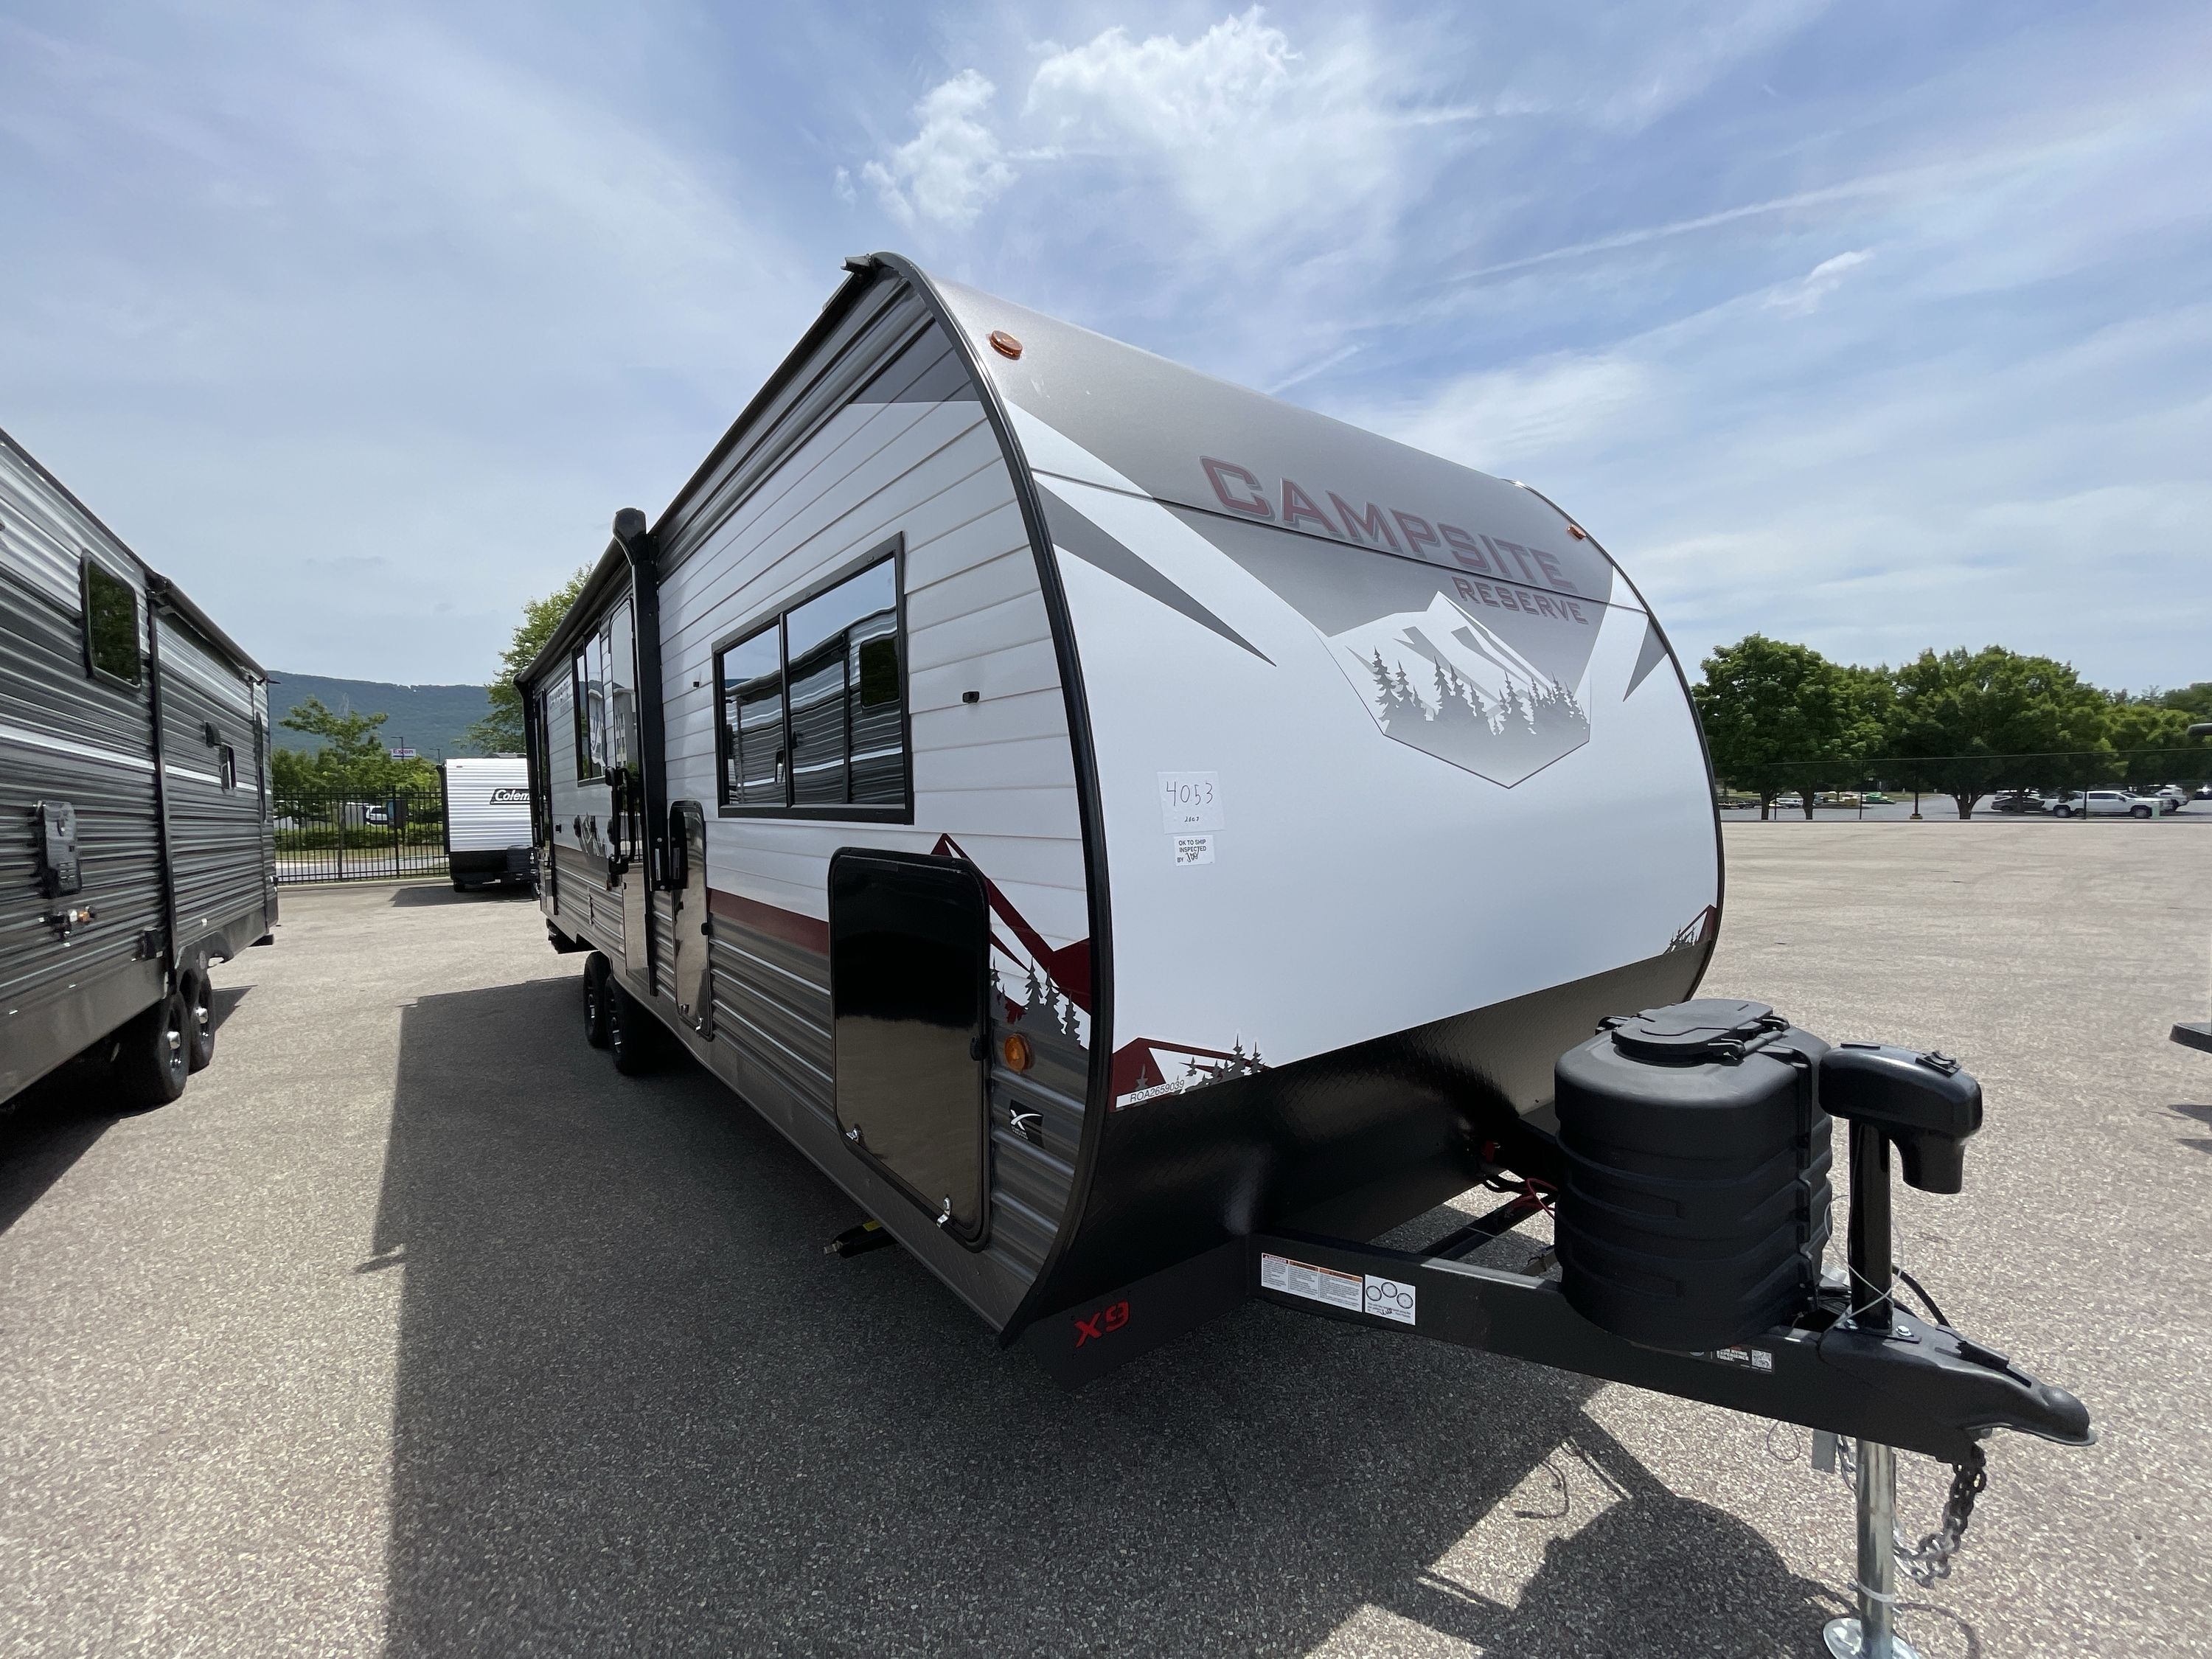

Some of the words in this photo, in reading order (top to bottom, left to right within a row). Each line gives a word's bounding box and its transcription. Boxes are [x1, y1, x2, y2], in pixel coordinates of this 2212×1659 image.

[1198, 455, 1578, 591] CAMPSITE
[1451, 576, 1589, 625] RESERVE
[495, 789, 530, 801] Colem
[1166, 781, 1214, 807] 4053
[1268, 1256, 1287, 1264] DANGER
[1074, 1300, 1130, 1349] X9
